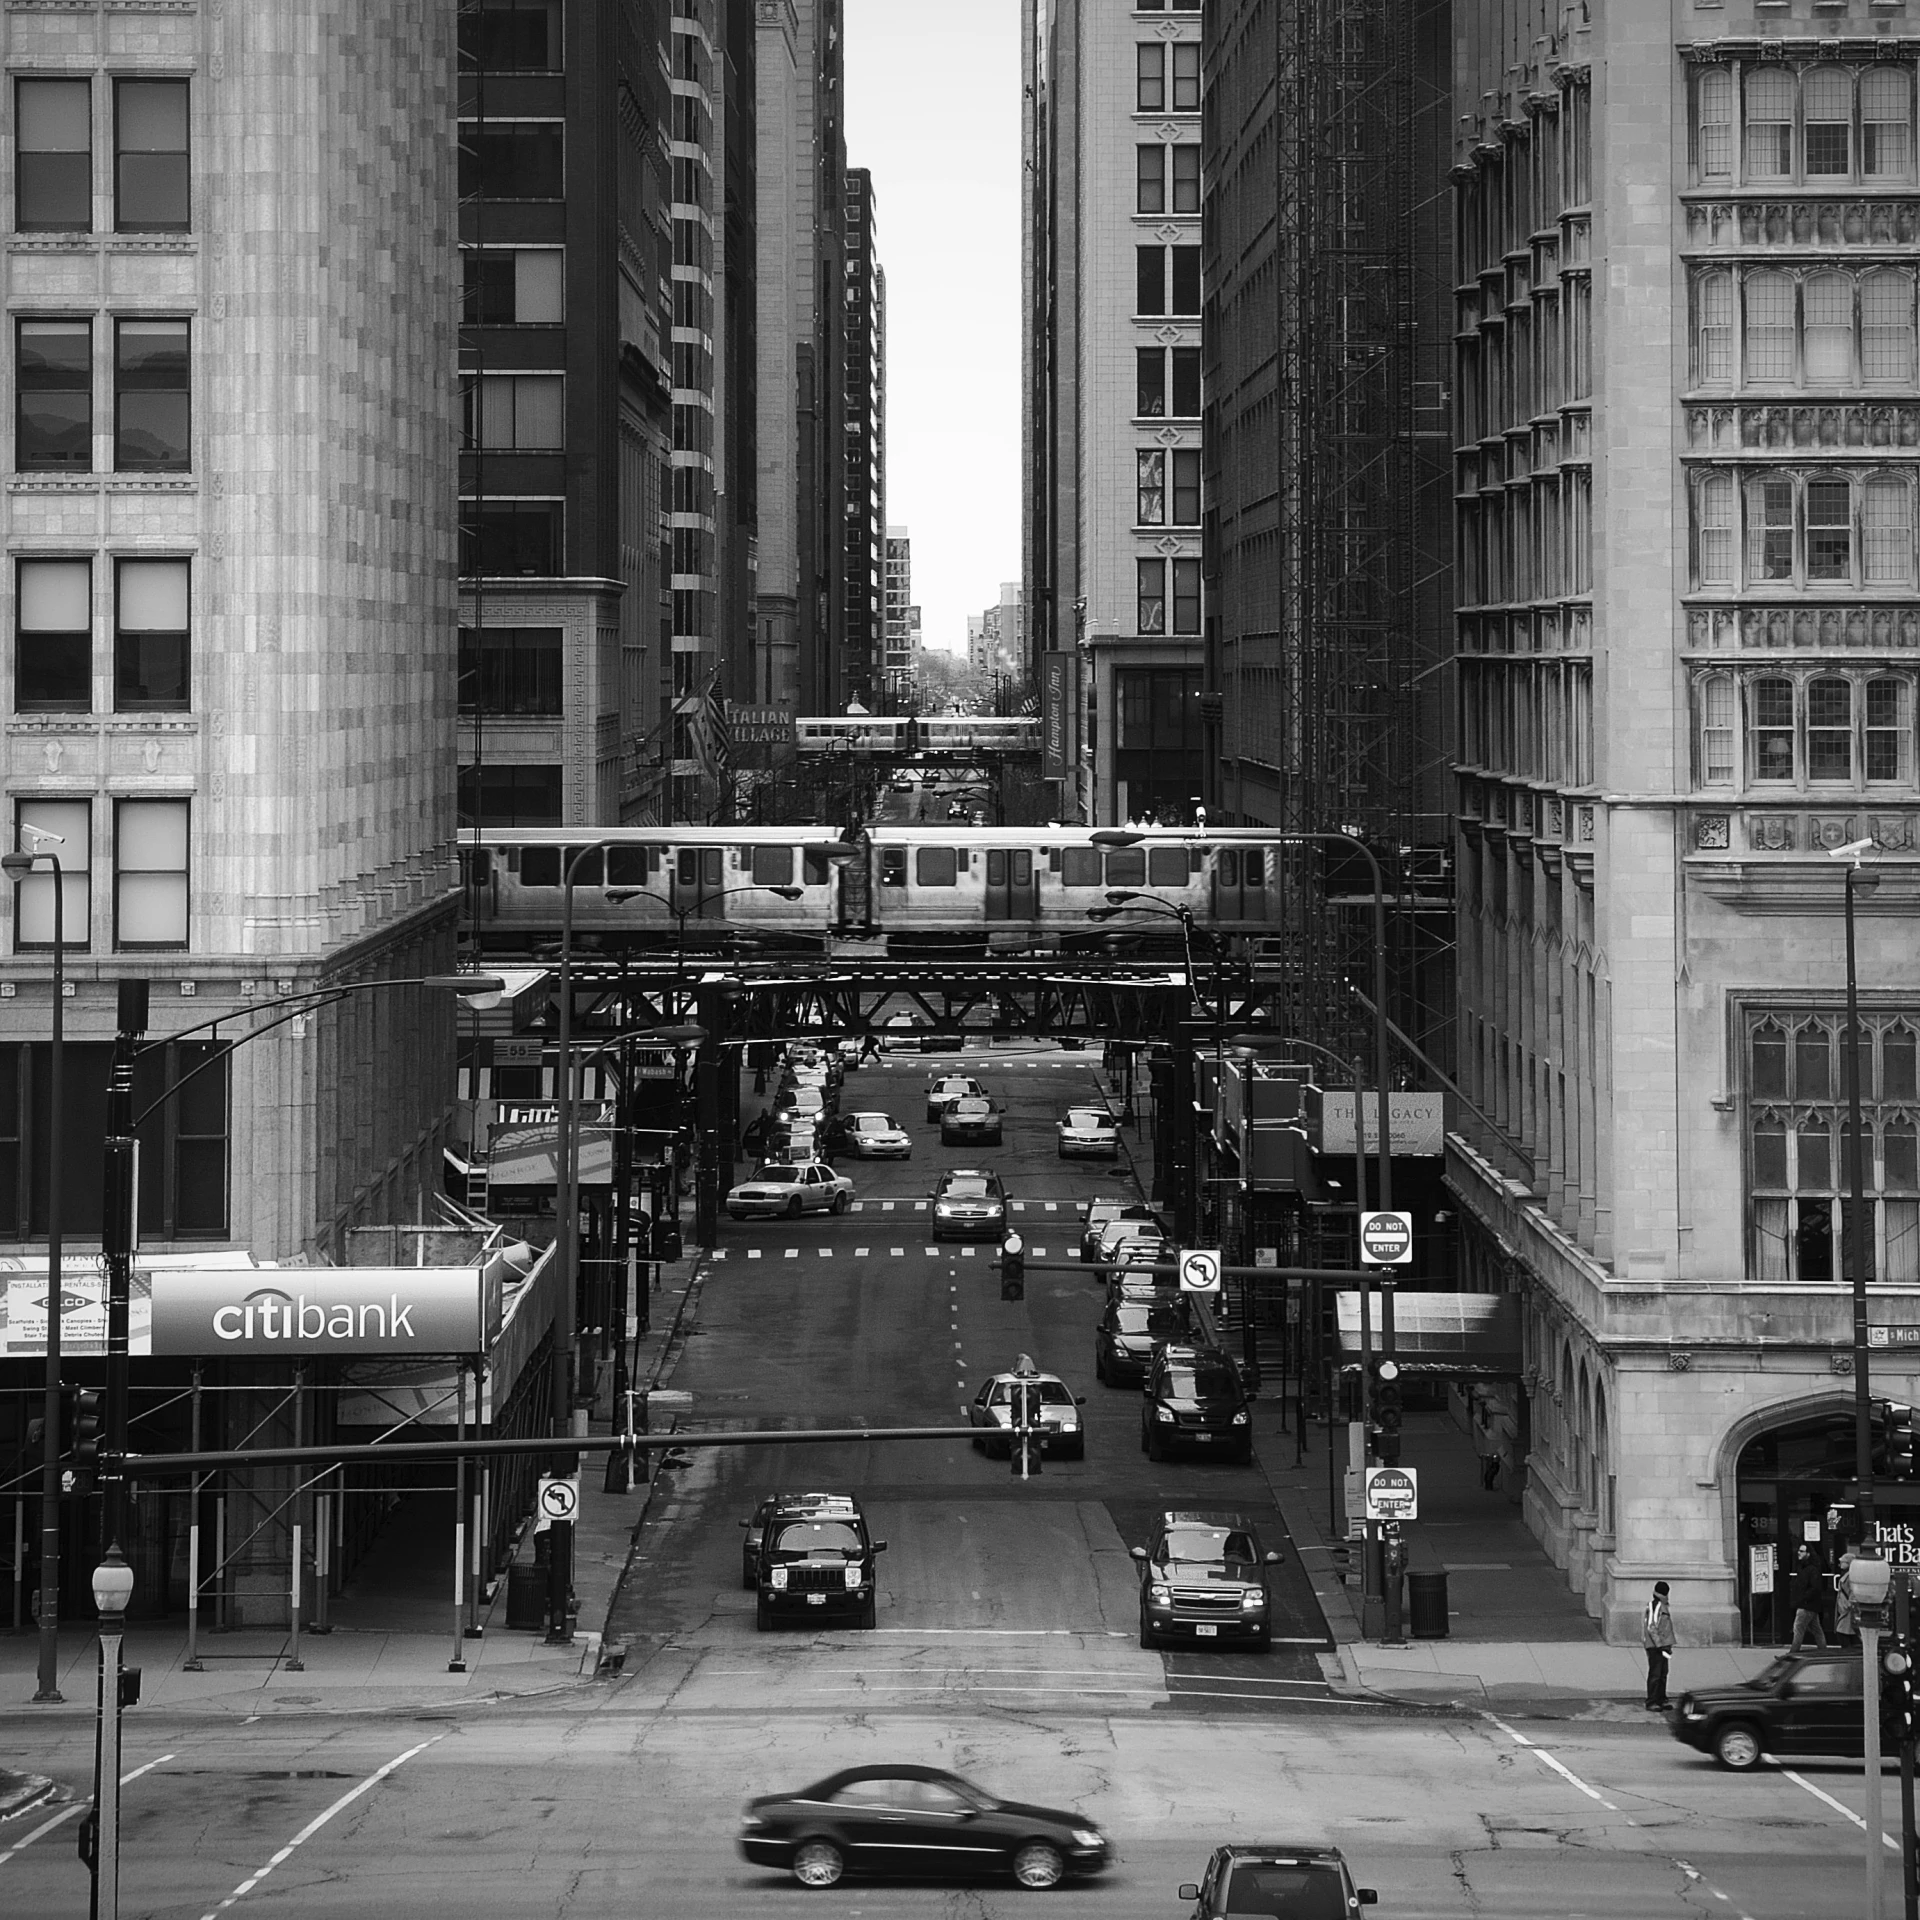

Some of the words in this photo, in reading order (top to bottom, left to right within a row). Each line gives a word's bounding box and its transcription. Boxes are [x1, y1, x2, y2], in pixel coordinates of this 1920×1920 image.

[1048, 665, 1062, 701] Inn
[724, 698, 790, 724] ITALIAN
[1048, 703, 1063, 767] Hampton
[509, 1045, 527, 1056] 55
[1334, 1108, 1356, 1119] TH
[1374, 1108, 1433, 1119] LGACY
[1369, 1222, 1381, 1231] DO
[1386, 1222, 1403, 1231] NOT
[1373, 1244, 1400, 1253] ENTER
[212, 1292, 415, 1340] citibank
[1897, 1329, 1919, 1341] Mich
[1374, 1478, 1386, 1487] DO
[1391, 1478, 1409, 1487] NOT
[1378, 1500, 1405, 1509] ENTER
[1750, 1517, 1768, 1529] 38
[1874, 1520, 1915, 1544] hat's
[1875, 1547, 1897, 1563] ur
